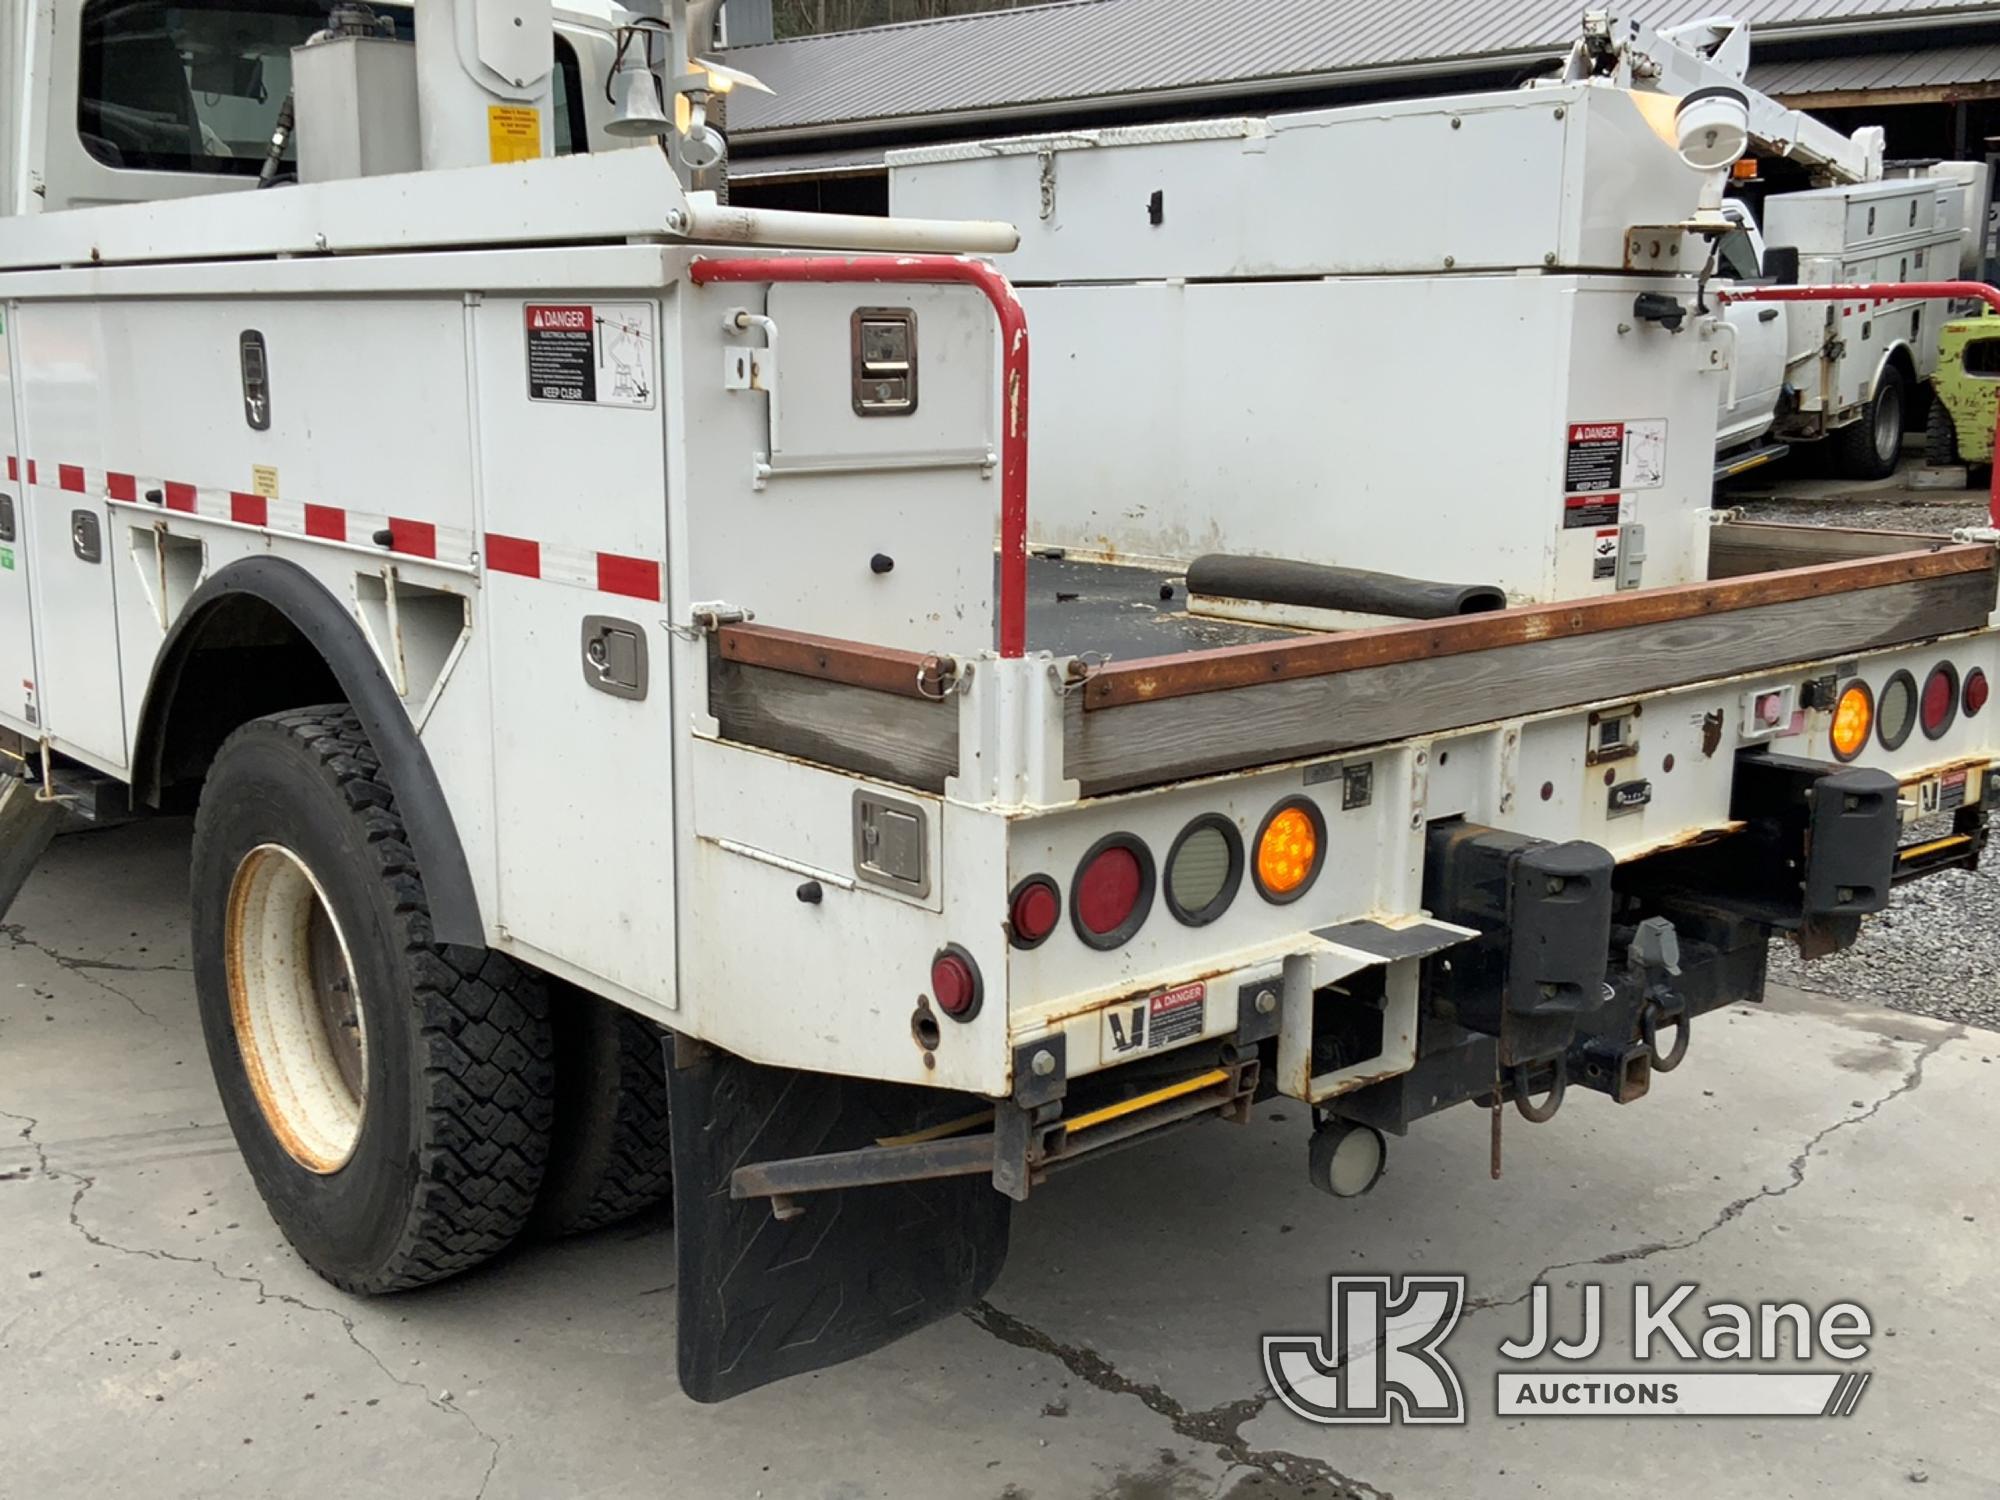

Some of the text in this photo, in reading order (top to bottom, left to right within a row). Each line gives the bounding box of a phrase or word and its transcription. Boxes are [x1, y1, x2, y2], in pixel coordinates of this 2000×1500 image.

[544, 310, 585, 328] DANGER
[543, 386, 582, 400] KEEP CLEAR
[1584, 426, 1618, 439] DANGER
[1163, 986, 1202, 1007] DANGER
